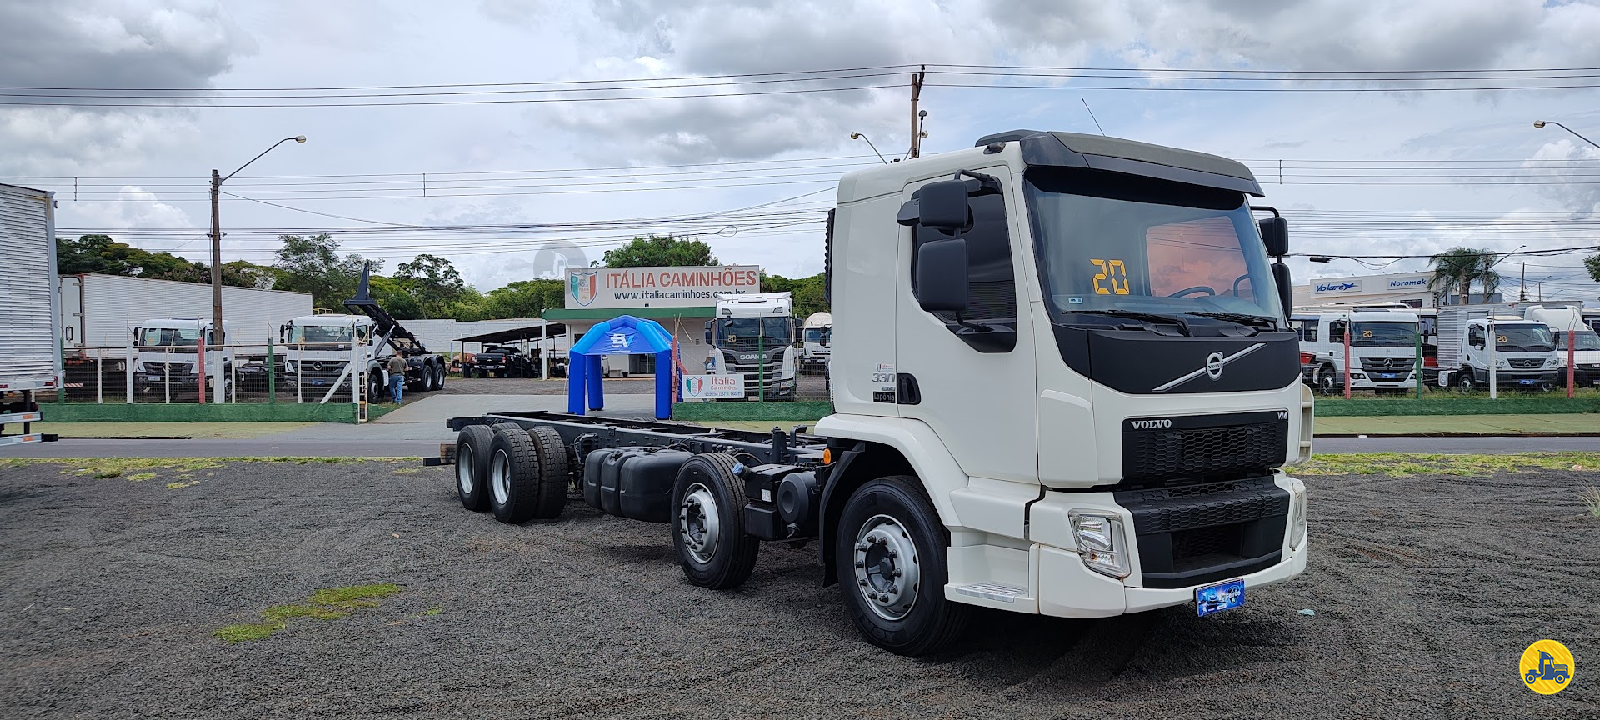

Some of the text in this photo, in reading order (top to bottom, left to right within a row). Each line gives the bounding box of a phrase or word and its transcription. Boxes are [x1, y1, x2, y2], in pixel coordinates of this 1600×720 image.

[606, 269, 656, 288] ITÁLIA
[659, 268, 757, 288] CAMINHÕES
[1089, 258, 1130, 295] 20
[1316, 282, 1345, 292] Volare
[1390, 279, 1427, 287] Noromak
[614, 288, 746, 299] www.italiacaminhoes.cb
[1362, 330, 1373, 338] 20
[1497, 335, 1508, 343] 20
[1276, 411, 1288, 420] VM
[1131, 419, 1173, 429] VOLVO
